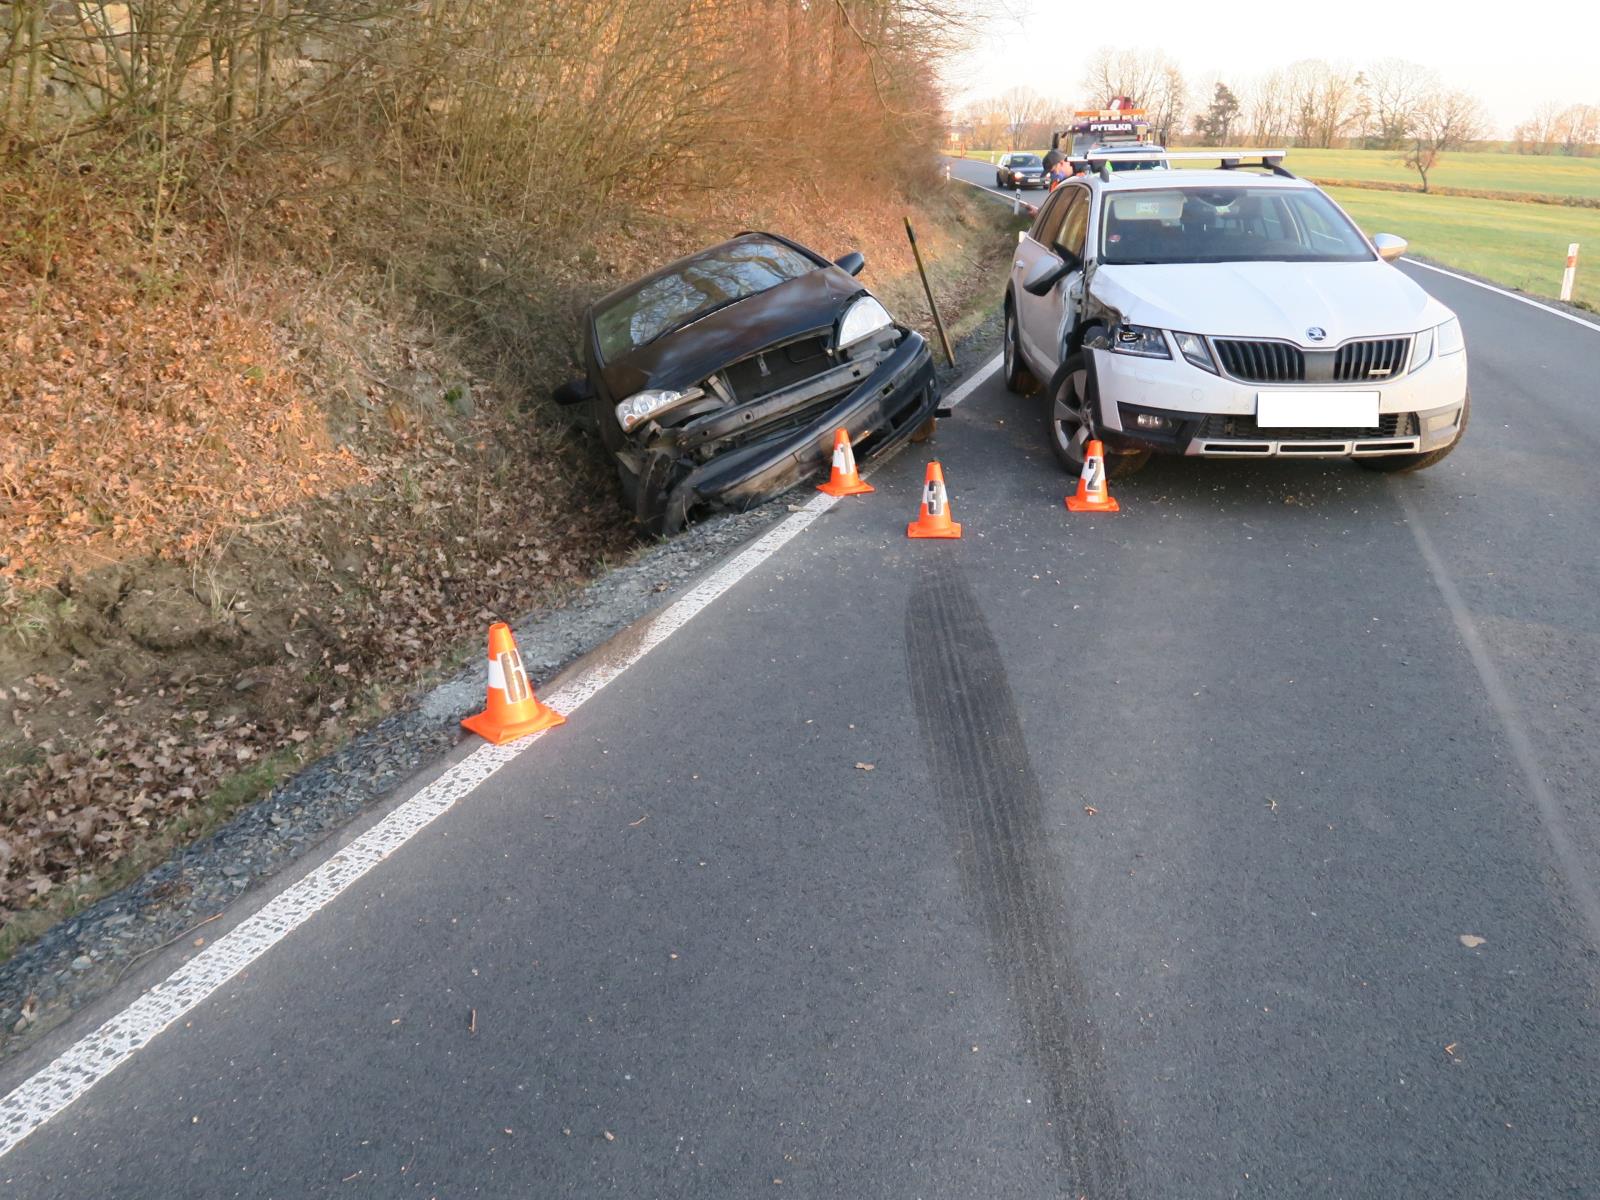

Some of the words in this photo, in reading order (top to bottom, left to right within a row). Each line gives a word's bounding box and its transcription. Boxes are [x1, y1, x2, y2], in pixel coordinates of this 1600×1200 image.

[840, 443, 850, 474] 1
[1087, 458, 1101, 490] 2
[927, 480, 942, 514] 3
